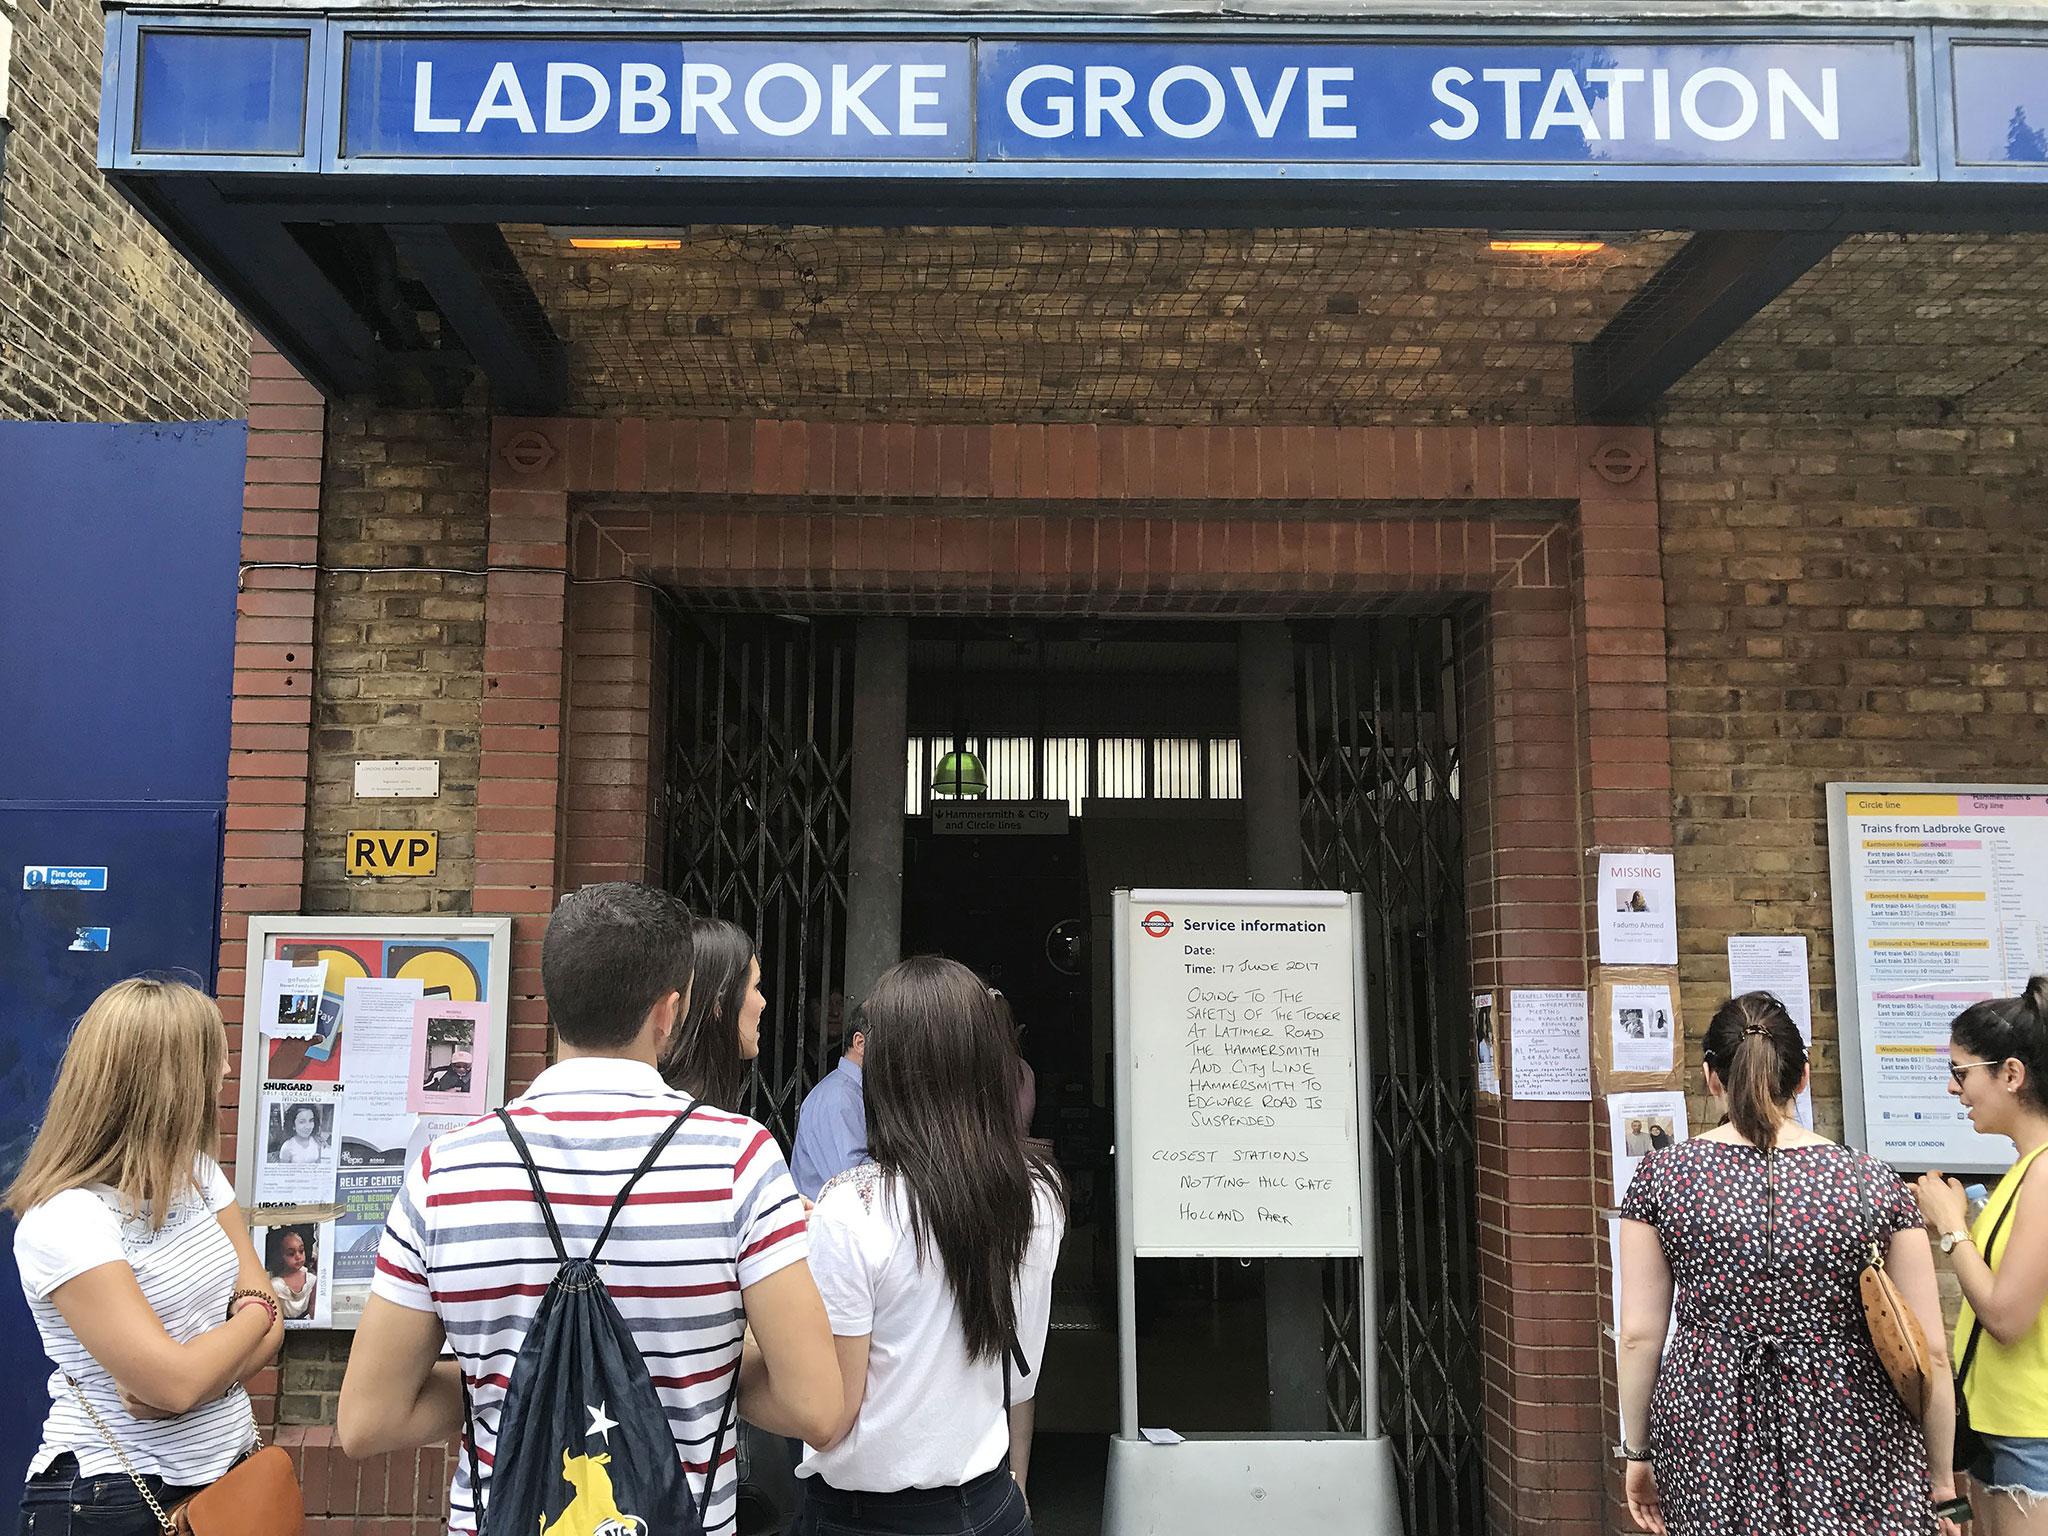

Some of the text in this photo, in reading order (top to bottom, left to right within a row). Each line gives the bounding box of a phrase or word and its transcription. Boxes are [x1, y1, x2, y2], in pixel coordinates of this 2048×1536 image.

[413, 60, 1840, 142] LADBROKE GROVE STATION
[945, 810, 1050, 822] Hammersmith & City
[944, 820, 1022, 830] and Circle lines
[1861, 824, 2006, 834] Trains from Ladbroke Grove
[355, 838, 430, 867] RVP
[50, 870, 86, 878] Fire door
[1610, 867, 1662, 878] MISSING
[1183, 918, 1326, 933] Service information
[1184, 945, 1215, 956] Date:
[1185, 959, 1320, 974] Time: 17 JUNE 2017
[1187, 986, 1304, 1003] OWING TO THE
[1186, 1006, 1236, 1023] SAFETY
[1244, 1008, 1264, 1020] OF
[1271, 1008, 1294, 1021] THE
[1187, 1022, 1324, 1040] AT LATIMER ROAD
[1185, 1038, 1320, 1057] THE HAMMERSMITH
[1190, 1058, 1314, 1077] AND CITY LINE
[263, 1082, 312, 1091] SHURGARD
[1190, 1078, 1322, 1092] HAMMERSMITH TO
[1188, 1094, 1322, 1109] EDGWARE ROAD IS
[1190, 1111, 1275, 1128] SUSPENDED
[348, 1157, 364, 1165] epic
[1152, 1150, 1309, 1162] CLOSEST STATIONS
[340, 1175, 402, 1187] RELIEF CENTRE
[1180, 1175, 1332, 1191] NOTTING HILL GATE
[364, 1212, 384, 1220] BOOKS
[1179, 1202, 1294, 1227] HOLLAND PARK
